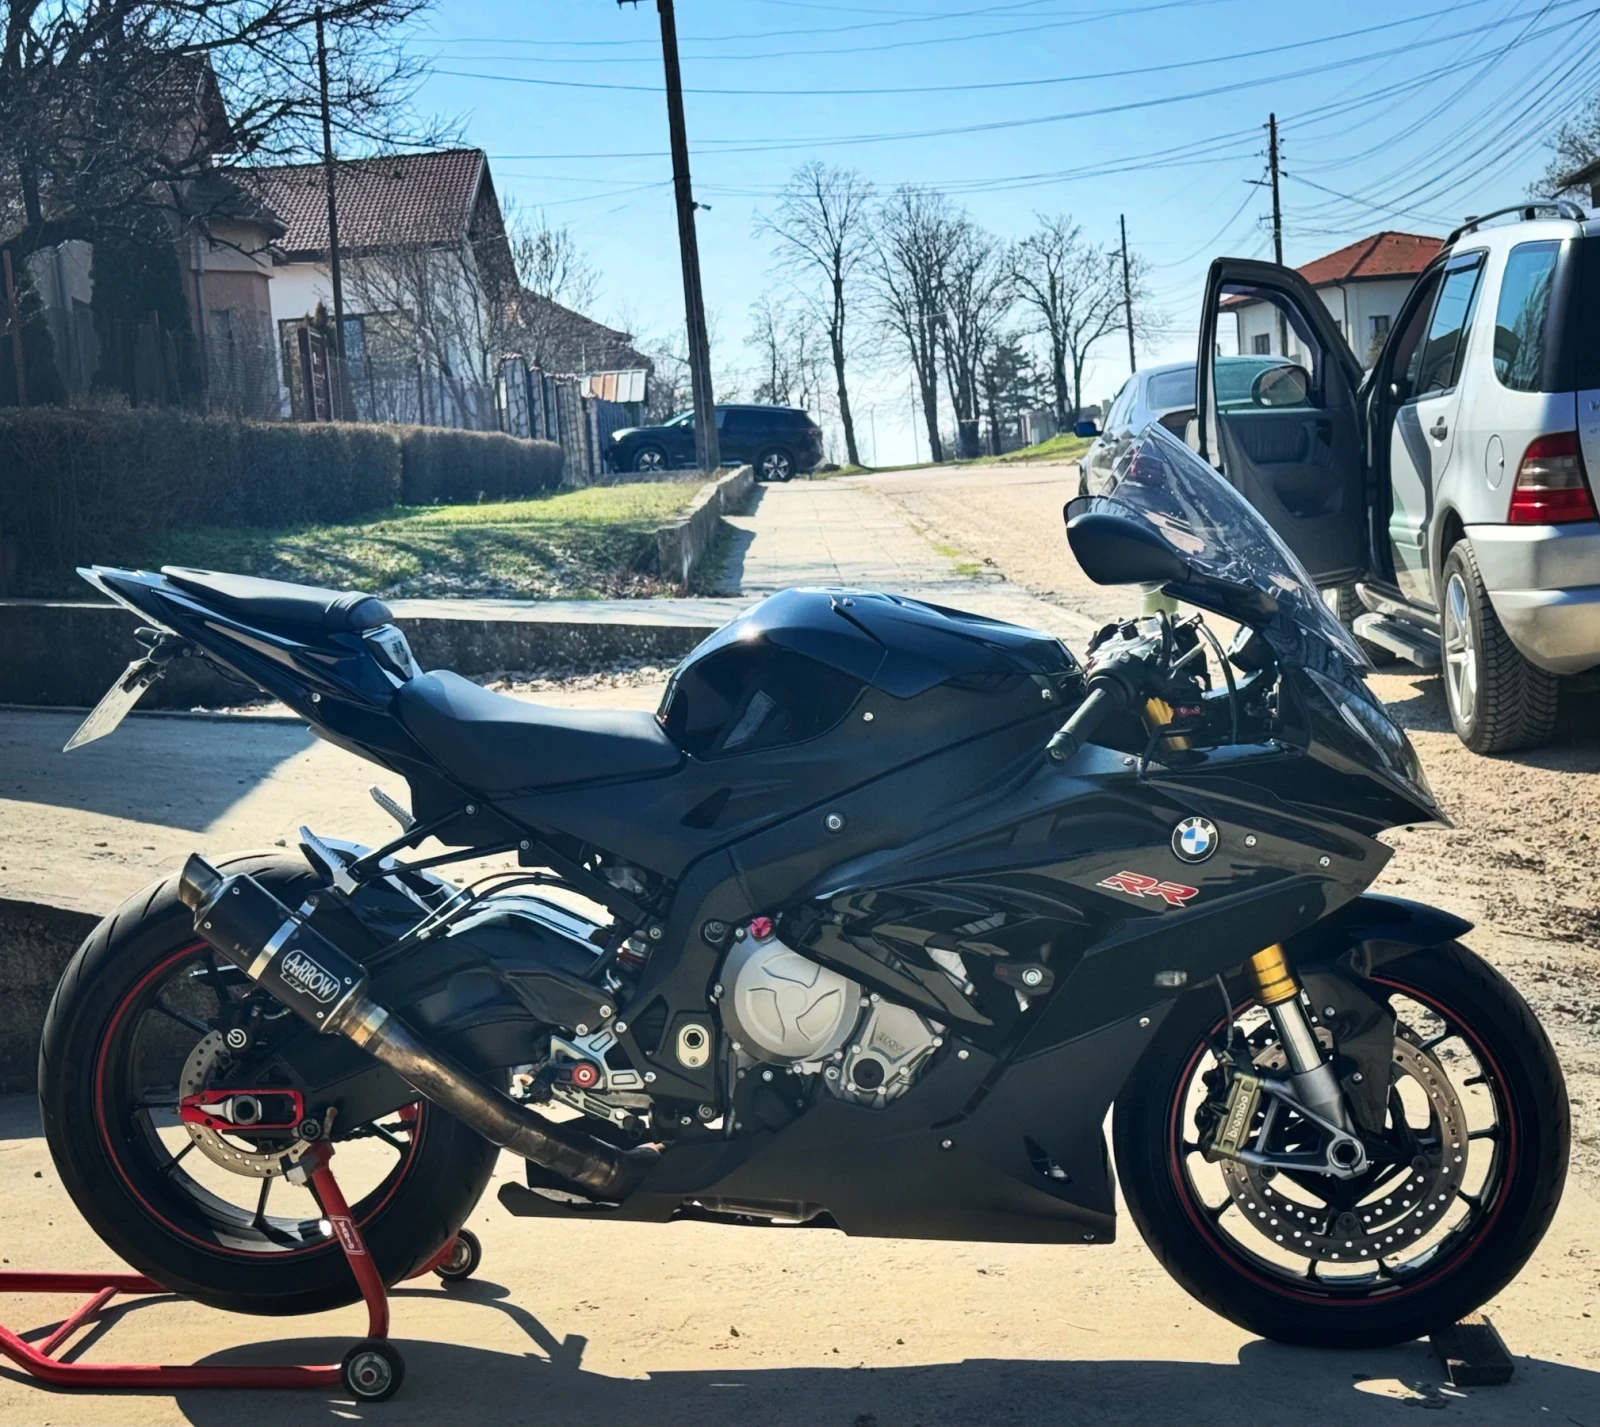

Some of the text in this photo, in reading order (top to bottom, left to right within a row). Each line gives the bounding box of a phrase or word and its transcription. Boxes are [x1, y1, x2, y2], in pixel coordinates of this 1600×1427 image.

[1177, 818, 1216, 835] BMW
[1101, 870, 1199, 908] RR
[284, 953, 338, 999] ARROW
[1227, 1095, 1249, 1139] brembo
